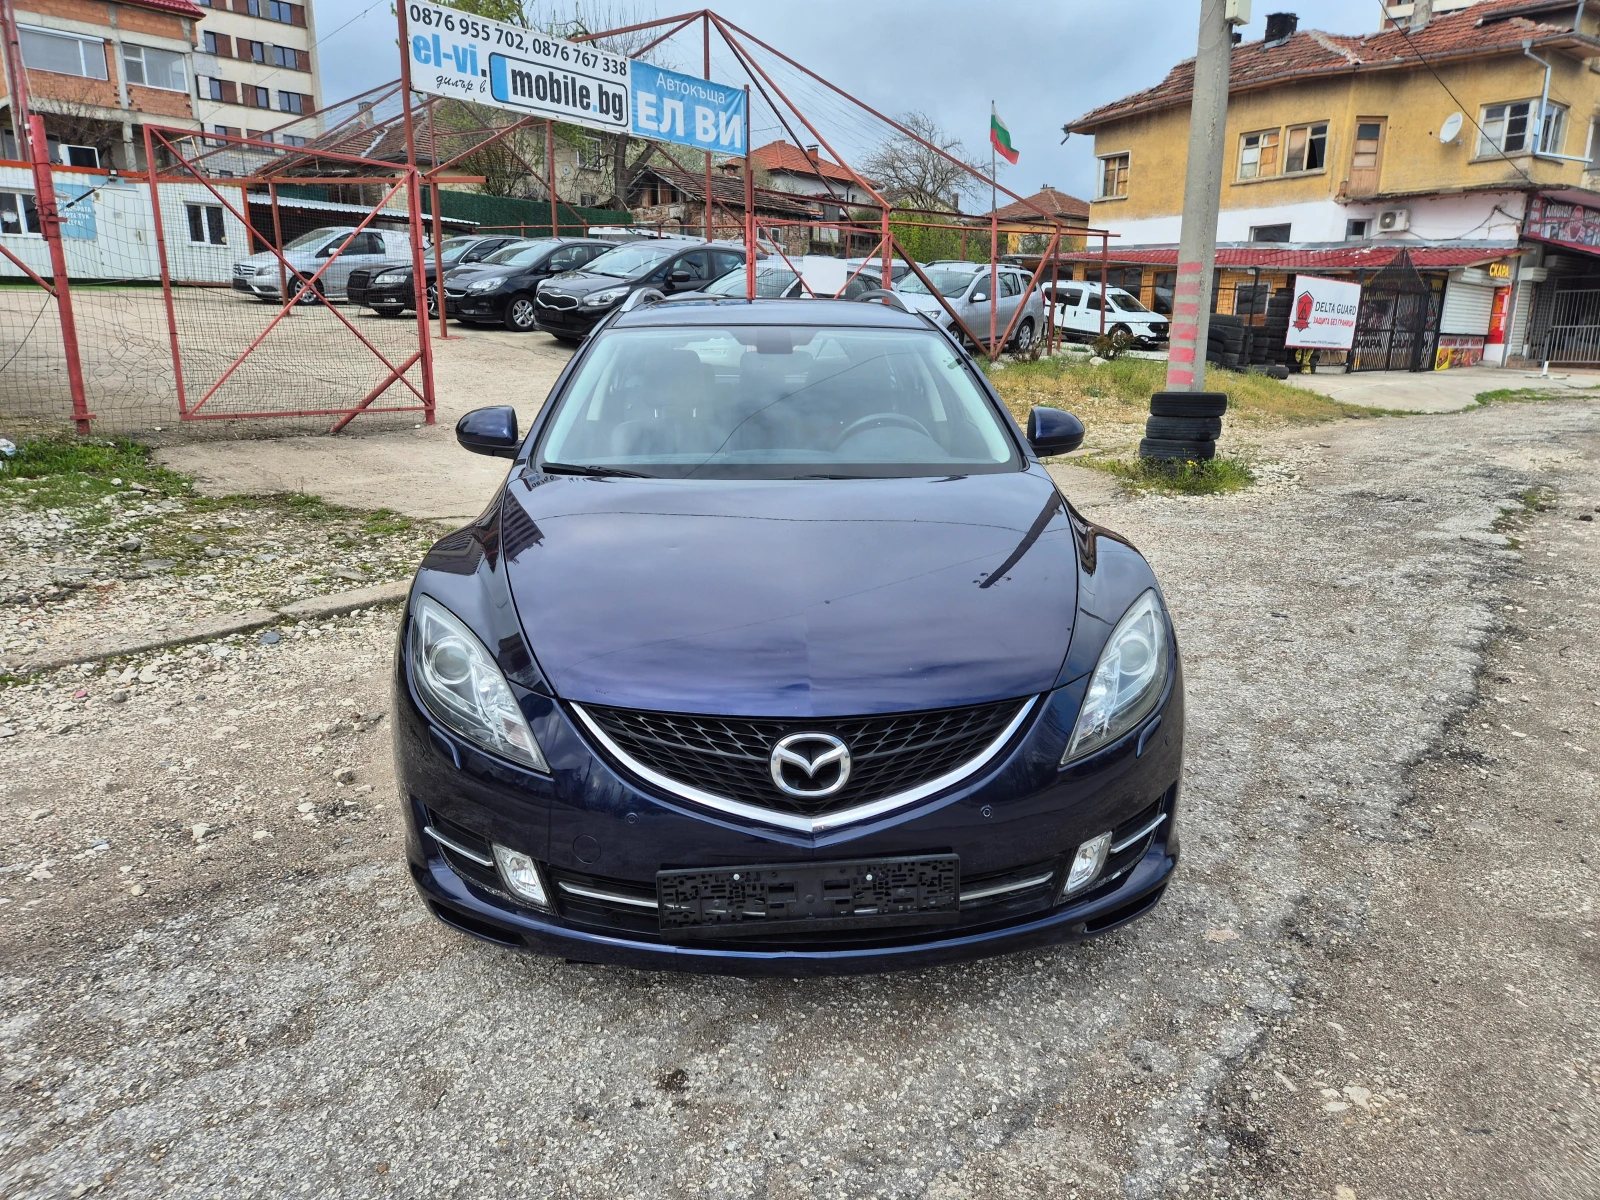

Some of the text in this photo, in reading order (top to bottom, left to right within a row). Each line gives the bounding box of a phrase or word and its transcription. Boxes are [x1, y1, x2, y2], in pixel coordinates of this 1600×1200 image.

[410, 4, 627, 76] 0876 955 702, 0876 767 338
[511, 69, 623, 121] mobile.bg
[656, 72, 725, 105] Автокъща
[637, 90, 741, 149] ЕЛ ВИ
[1489, 262, 1510, 278] СКАРА
[1315, 301, 1357, 316] DELTA GUARD
